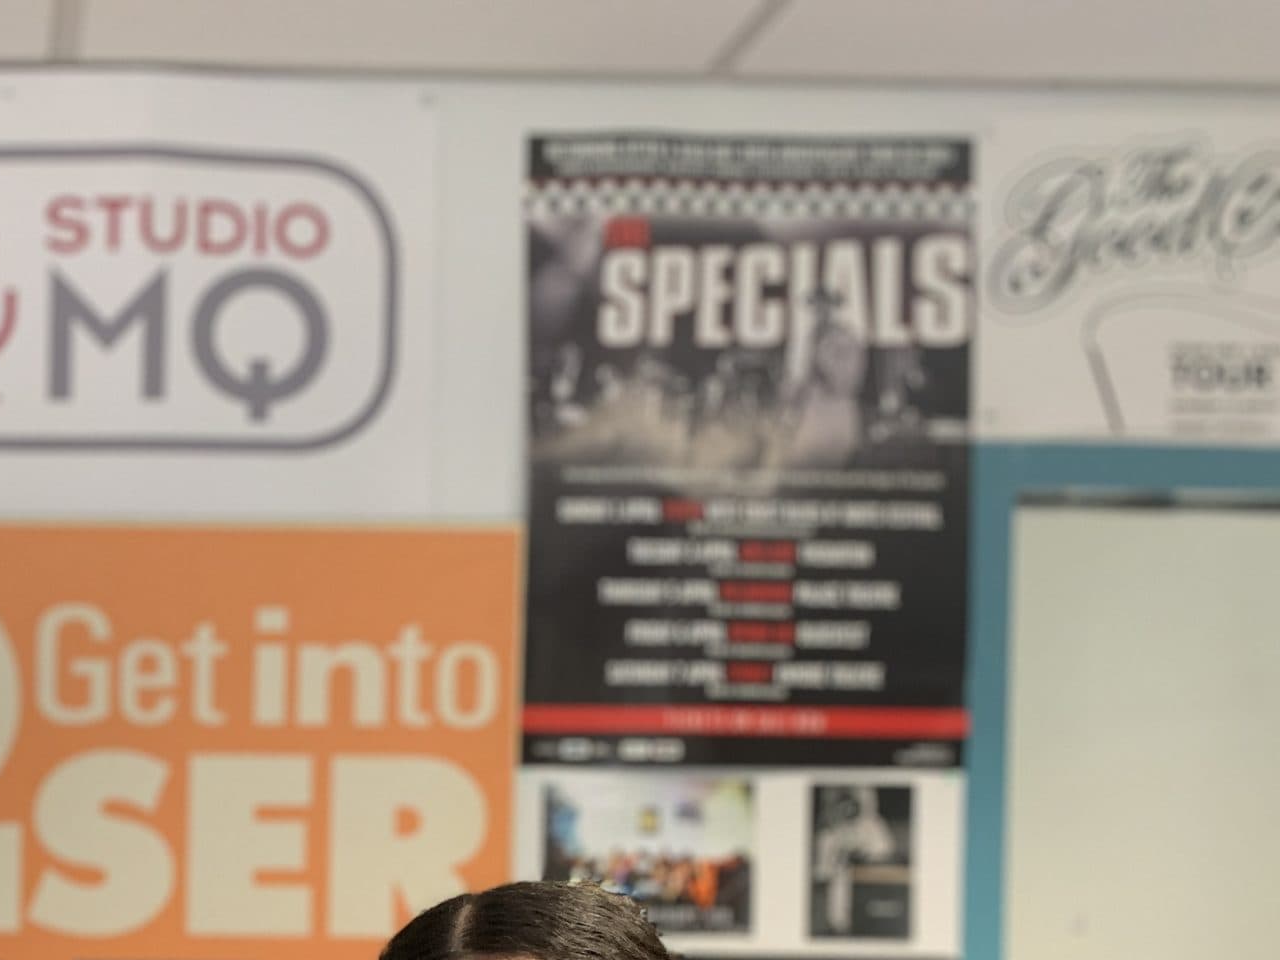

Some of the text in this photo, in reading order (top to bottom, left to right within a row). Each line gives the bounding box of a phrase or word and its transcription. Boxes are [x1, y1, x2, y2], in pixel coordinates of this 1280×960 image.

[45, 194, 331, 261] STUDIO
[47, 264, 332, 424] MQ
[596, 234, 971, 349] SPECIALS
[34, 603, 499, 730] Get into
